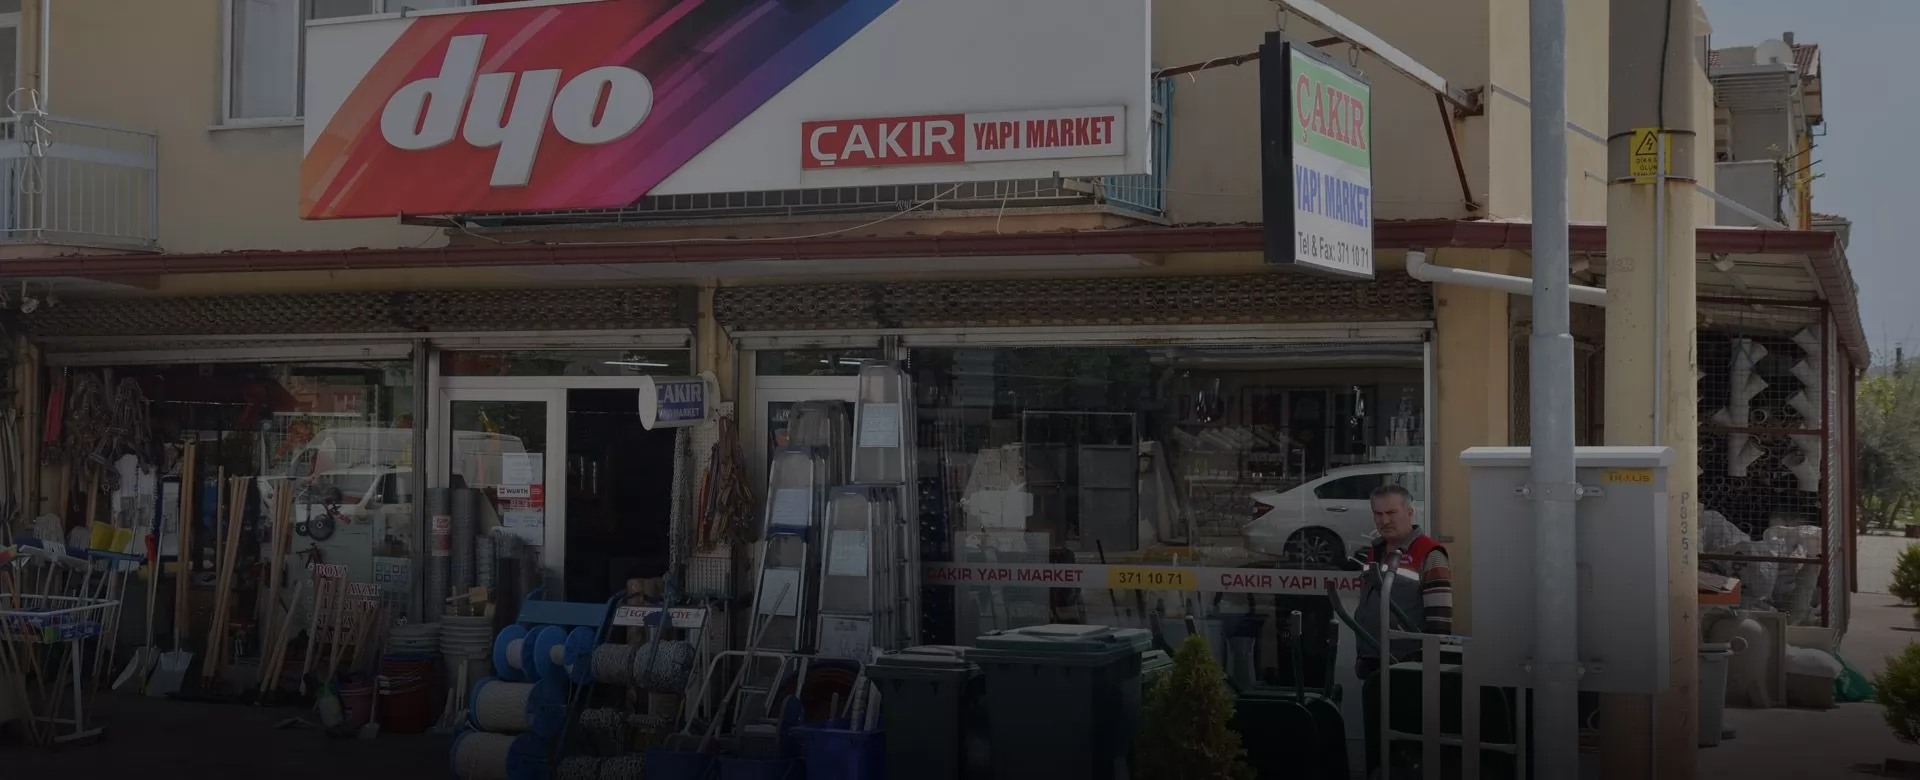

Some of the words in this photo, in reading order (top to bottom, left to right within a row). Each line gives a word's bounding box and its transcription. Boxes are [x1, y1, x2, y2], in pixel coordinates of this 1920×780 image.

[380, 34, 654, 187] dyo
[1296, 74, 1366, 150] ÇAKIR
[809, 120, 956, 166] ÇAKIR
[973, 121, 1019, 150] YAPI
[1026, 116, 1115, 148] MARKET
[1296, 164, 1322, 216] YAPI
[1325, 174, 1370, 228] MARKET
[1298, 231, 1309, 255] Tel
[1311, 234, 1318, 258] &
[1319, 236, 1336, 261] Fax:
[1337, 241, 1349, 263] 371
[1351, 246, 1360, 266] 10
[1360, 247, 1370, 269] 71
[316, 564, 349, 577] BOYA
[977, 568, 1012, 582] YAPI
[1017, 569, 1084, 582] MARKET
[1119, 572, 1142, 584] 371
[1148, 573, 1162, 585] 10
[1168, 573, 1183, 585] 71
[1220, 573, 1272, 590] ÇAKIR
[1279, 575, 1317, 589] YAPI
